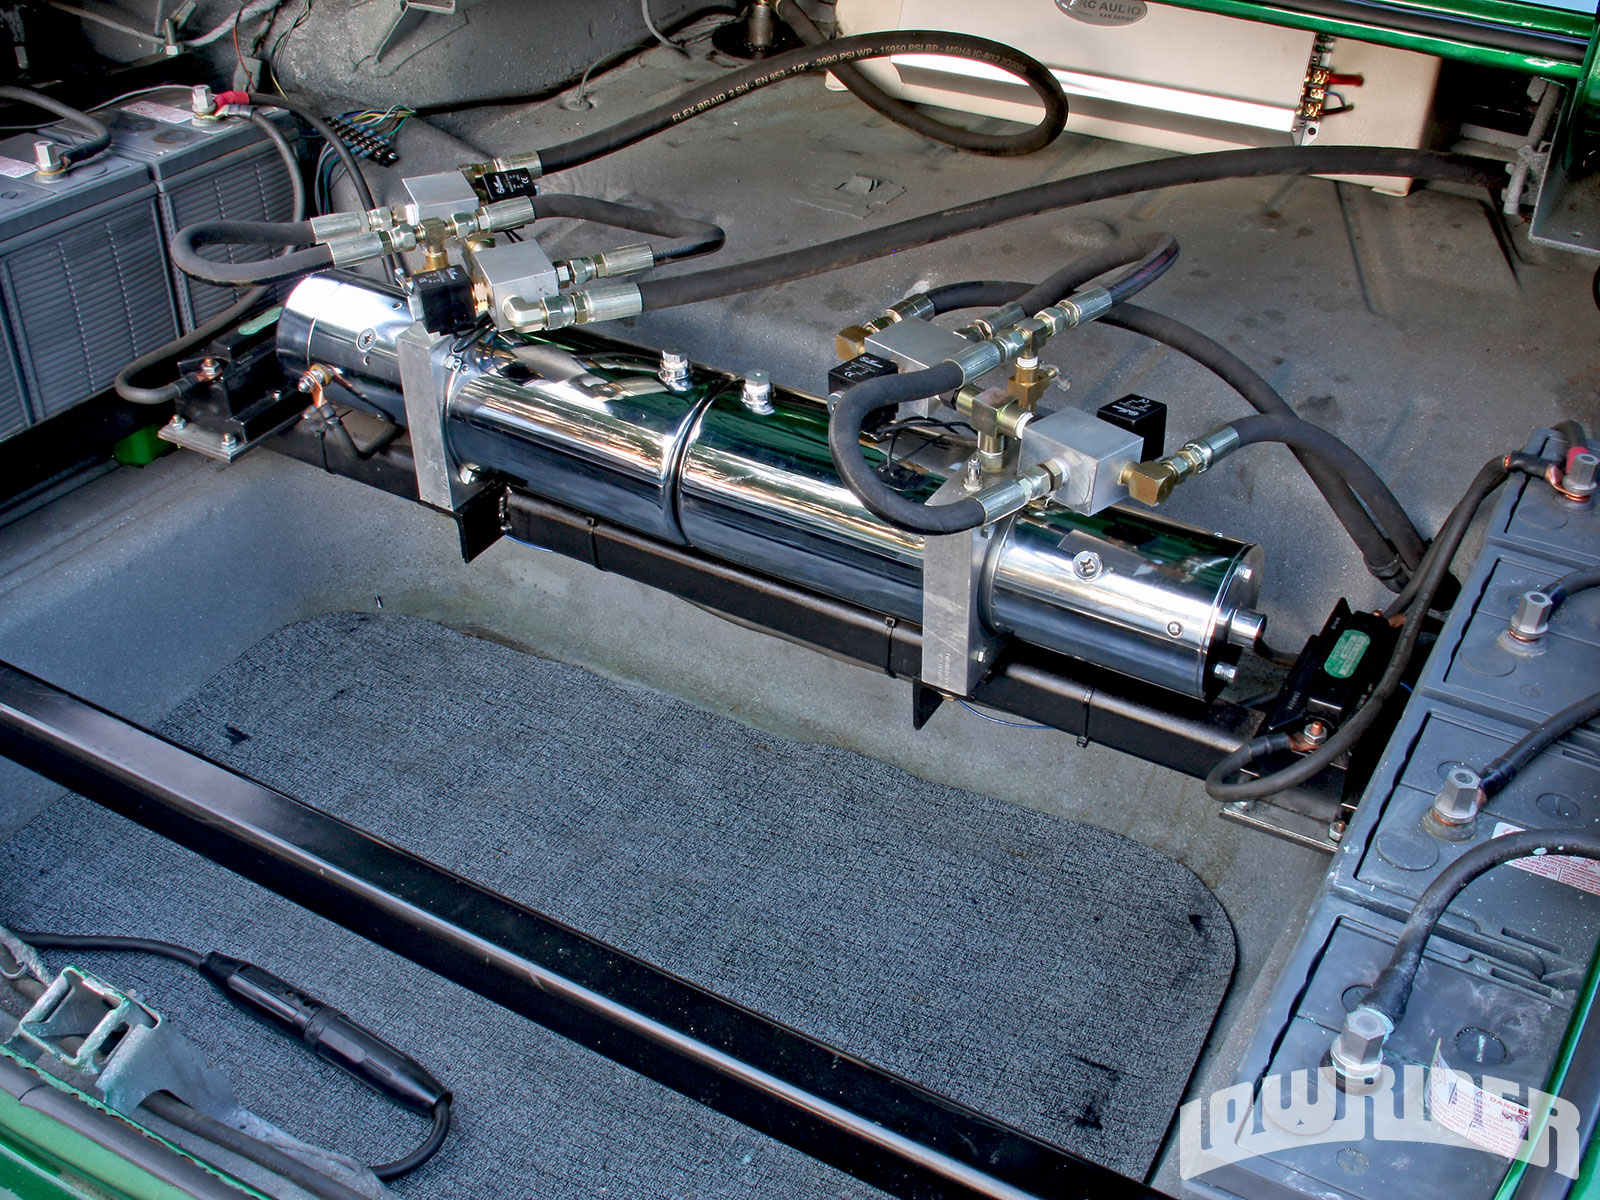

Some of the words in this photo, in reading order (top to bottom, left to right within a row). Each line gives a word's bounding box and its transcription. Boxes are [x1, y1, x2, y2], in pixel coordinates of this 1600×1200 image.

[1099, 1, 1141, 15] AUDIO
[672, 93, 726, 122] FLEX-BRAID
[728, 89, 734, 97] 2
[735, 82, 750, 94] SN
[755, 75, 769, 87] EN
[839, 51, 855, 61] PSI
[856, 47, 873, 57] WP
[880, 44, 907, 53] 15950
[908, 43, 924, 52] PSI
[925, 43, 939, 52] BP
[945, 45, 971, 57] MSHA
